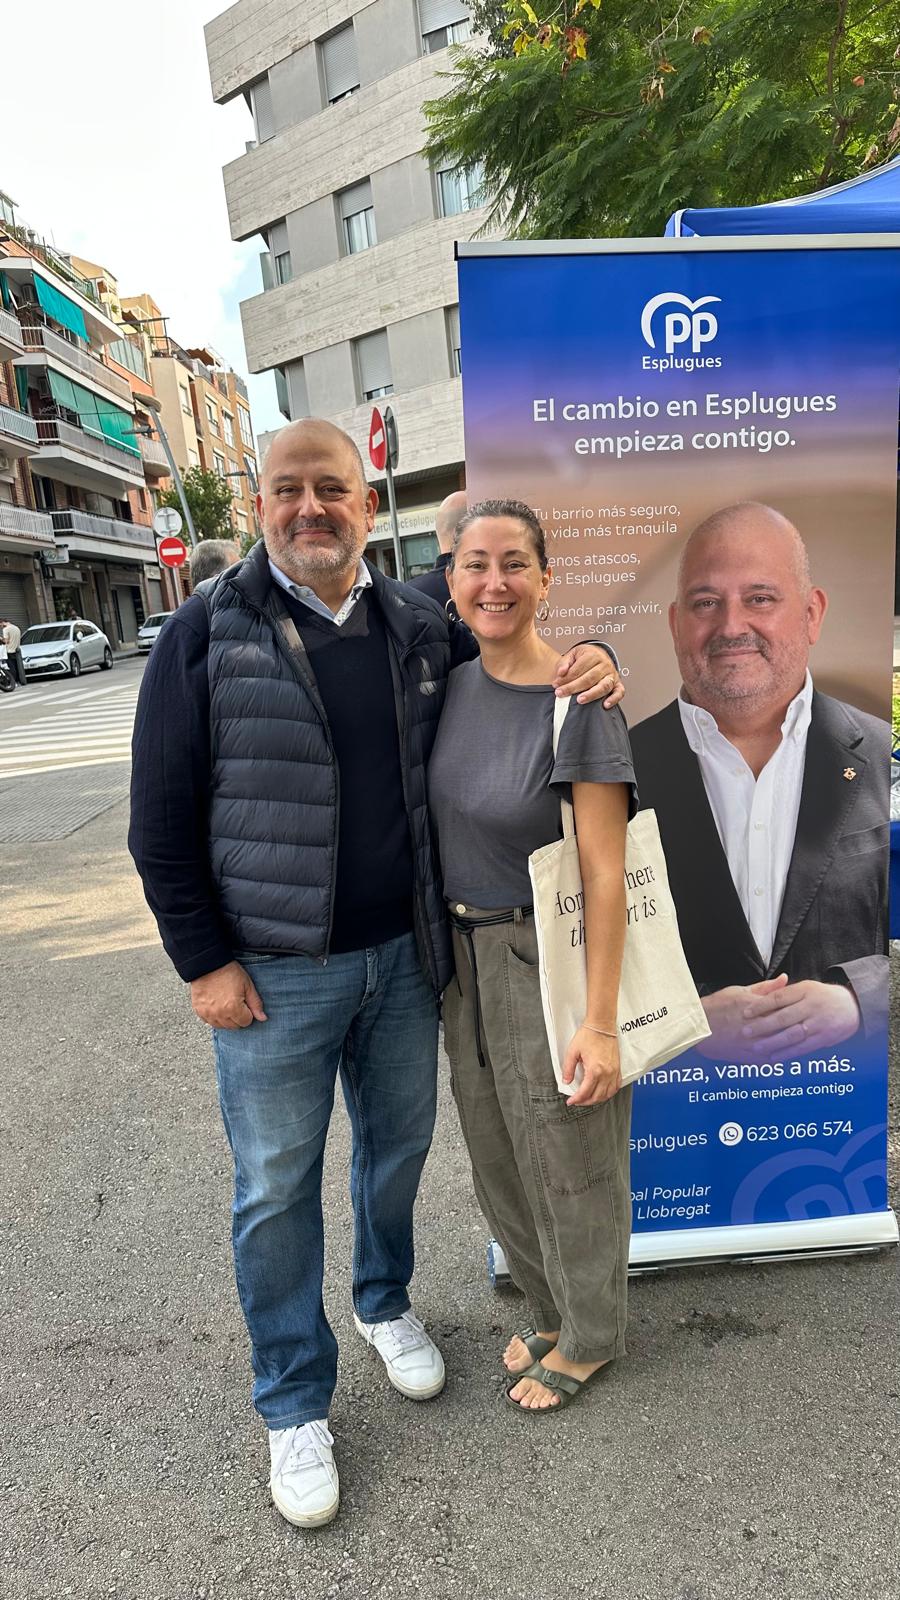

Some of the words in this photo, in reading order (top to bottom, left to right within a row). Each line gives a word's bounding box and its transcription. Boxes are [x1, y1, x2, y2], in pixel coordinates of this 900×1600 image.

[665, 312, 718, 353] pp
[642, 355, 722, 372] Esplugues
[533, 398, 555, 422] El
[562, 396, 659, 421] cambio
[666, 399, 697, 417] en
[706, 391, 837, 420] Esplugues
[574, 430, 684, 458] empieza
[691, 426, 796, 452] contigo.
[532, 507, 548, 521] Tu
[552, 506, 594, 520] barrio
[598, 505, 626, 518] más
[630, 504, 681, 520] seguro,
[551, 525, 580, 538] vida
[584, 524, 611, 537] más
[615, 521, 677, 538] tranquila
[547, 556, 580, 567] enos
[584, 552, 641, 566] atascos,
[566, 571, 636, 587] Esplugues
[535, 604, 593, 619] Vivienda
[596, 605, 627, 619] para
[630, 601, 662, 616] vivir,
[535, 626, 551, 637] no
[555, 625, 585, 638] para
[589, 621, 627, 634] soñar
[642, 895, 657, 918] is
[620, 1006, 668, 1034] HOMECLUB
[715, 1063, 784, 1080] vamos
[790, 1061, 801, 1075] a
[808, 1055, 856, 1073] más.
[688, 1091, 699, 1103] El
[702, 1088, 748, 1102] cambio
[751, 1085, 803, 1100] empieza
[806, 1082, 854, 1096] contigo
[628, 1131, 708, 1153] splugues
[746, 1125, 779, 1142] 623
[783, 1122, 818, 1139] 066
[822, 1120, 853, 1136] 574
[652, 1184, 712, 1202] Popular
[637, 1203, 711, 1220] Llobregat
